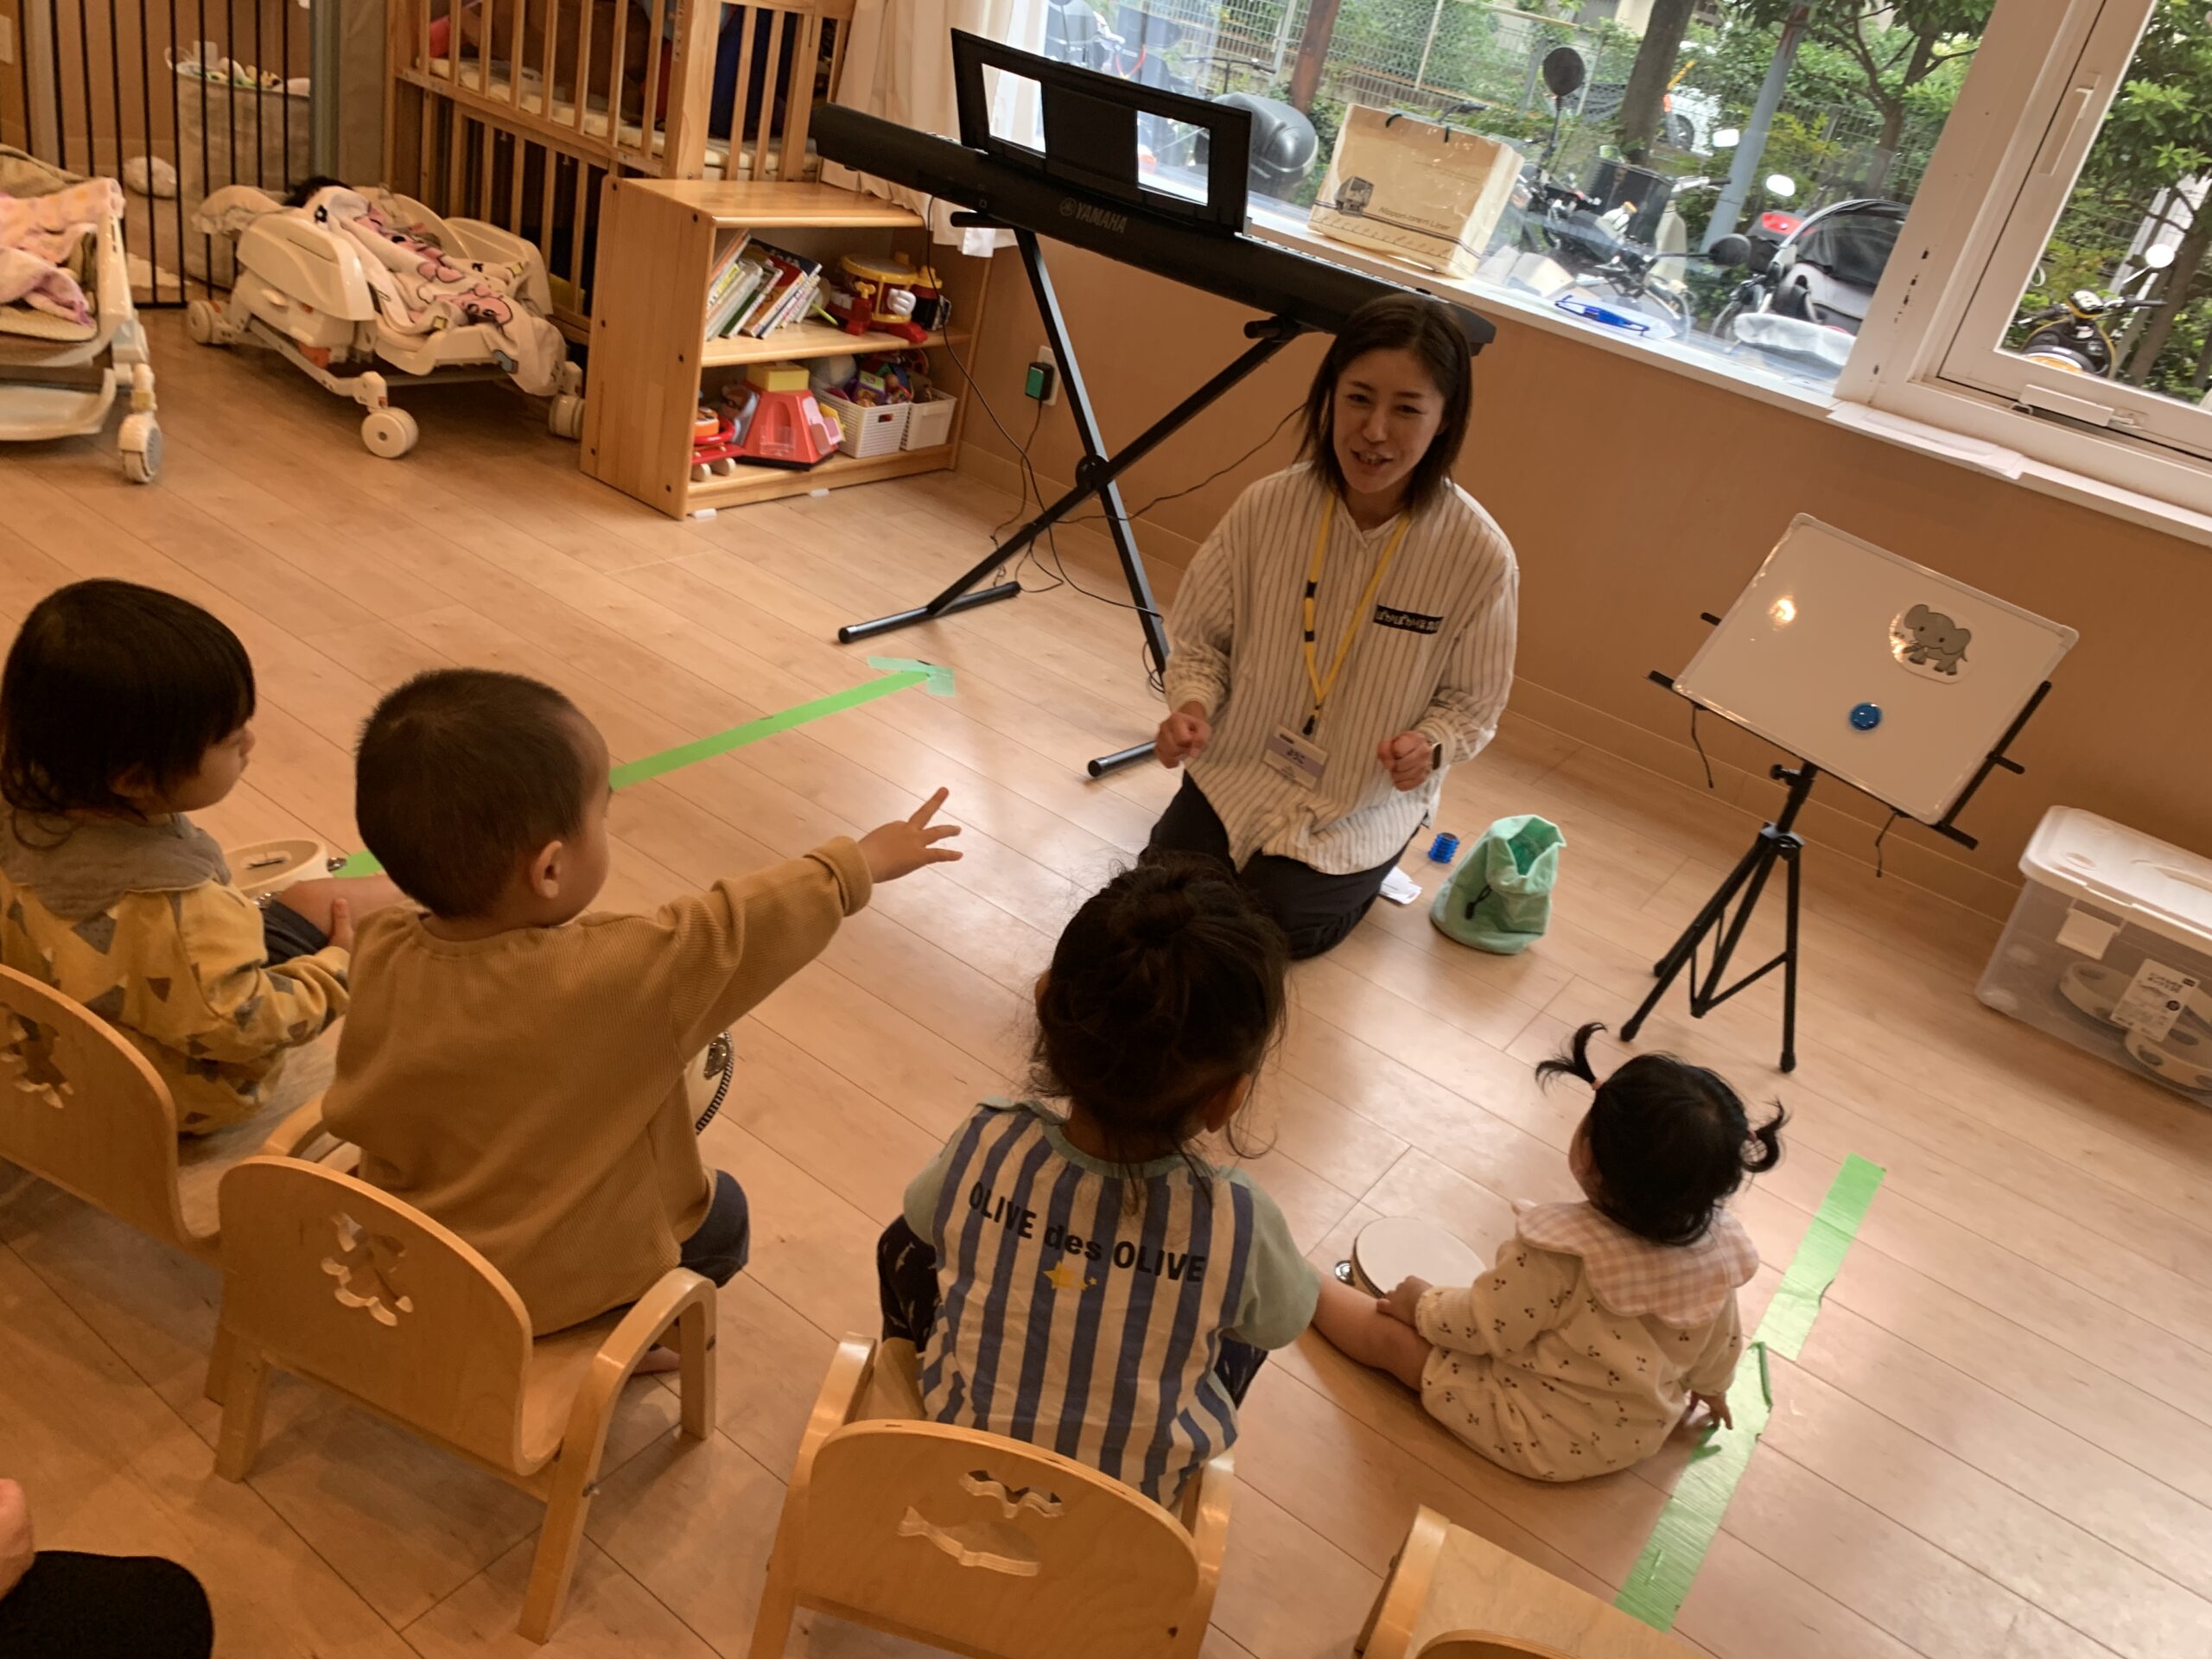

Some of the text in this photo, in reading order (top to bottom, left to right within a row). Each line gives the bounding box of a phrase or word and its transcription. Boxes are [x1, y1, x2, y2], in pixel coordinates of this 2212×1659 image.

[1076, 201, 1128, 233] YAMAHA
[969, 1180, 1206, 1283] OLIVE des OLIVE
